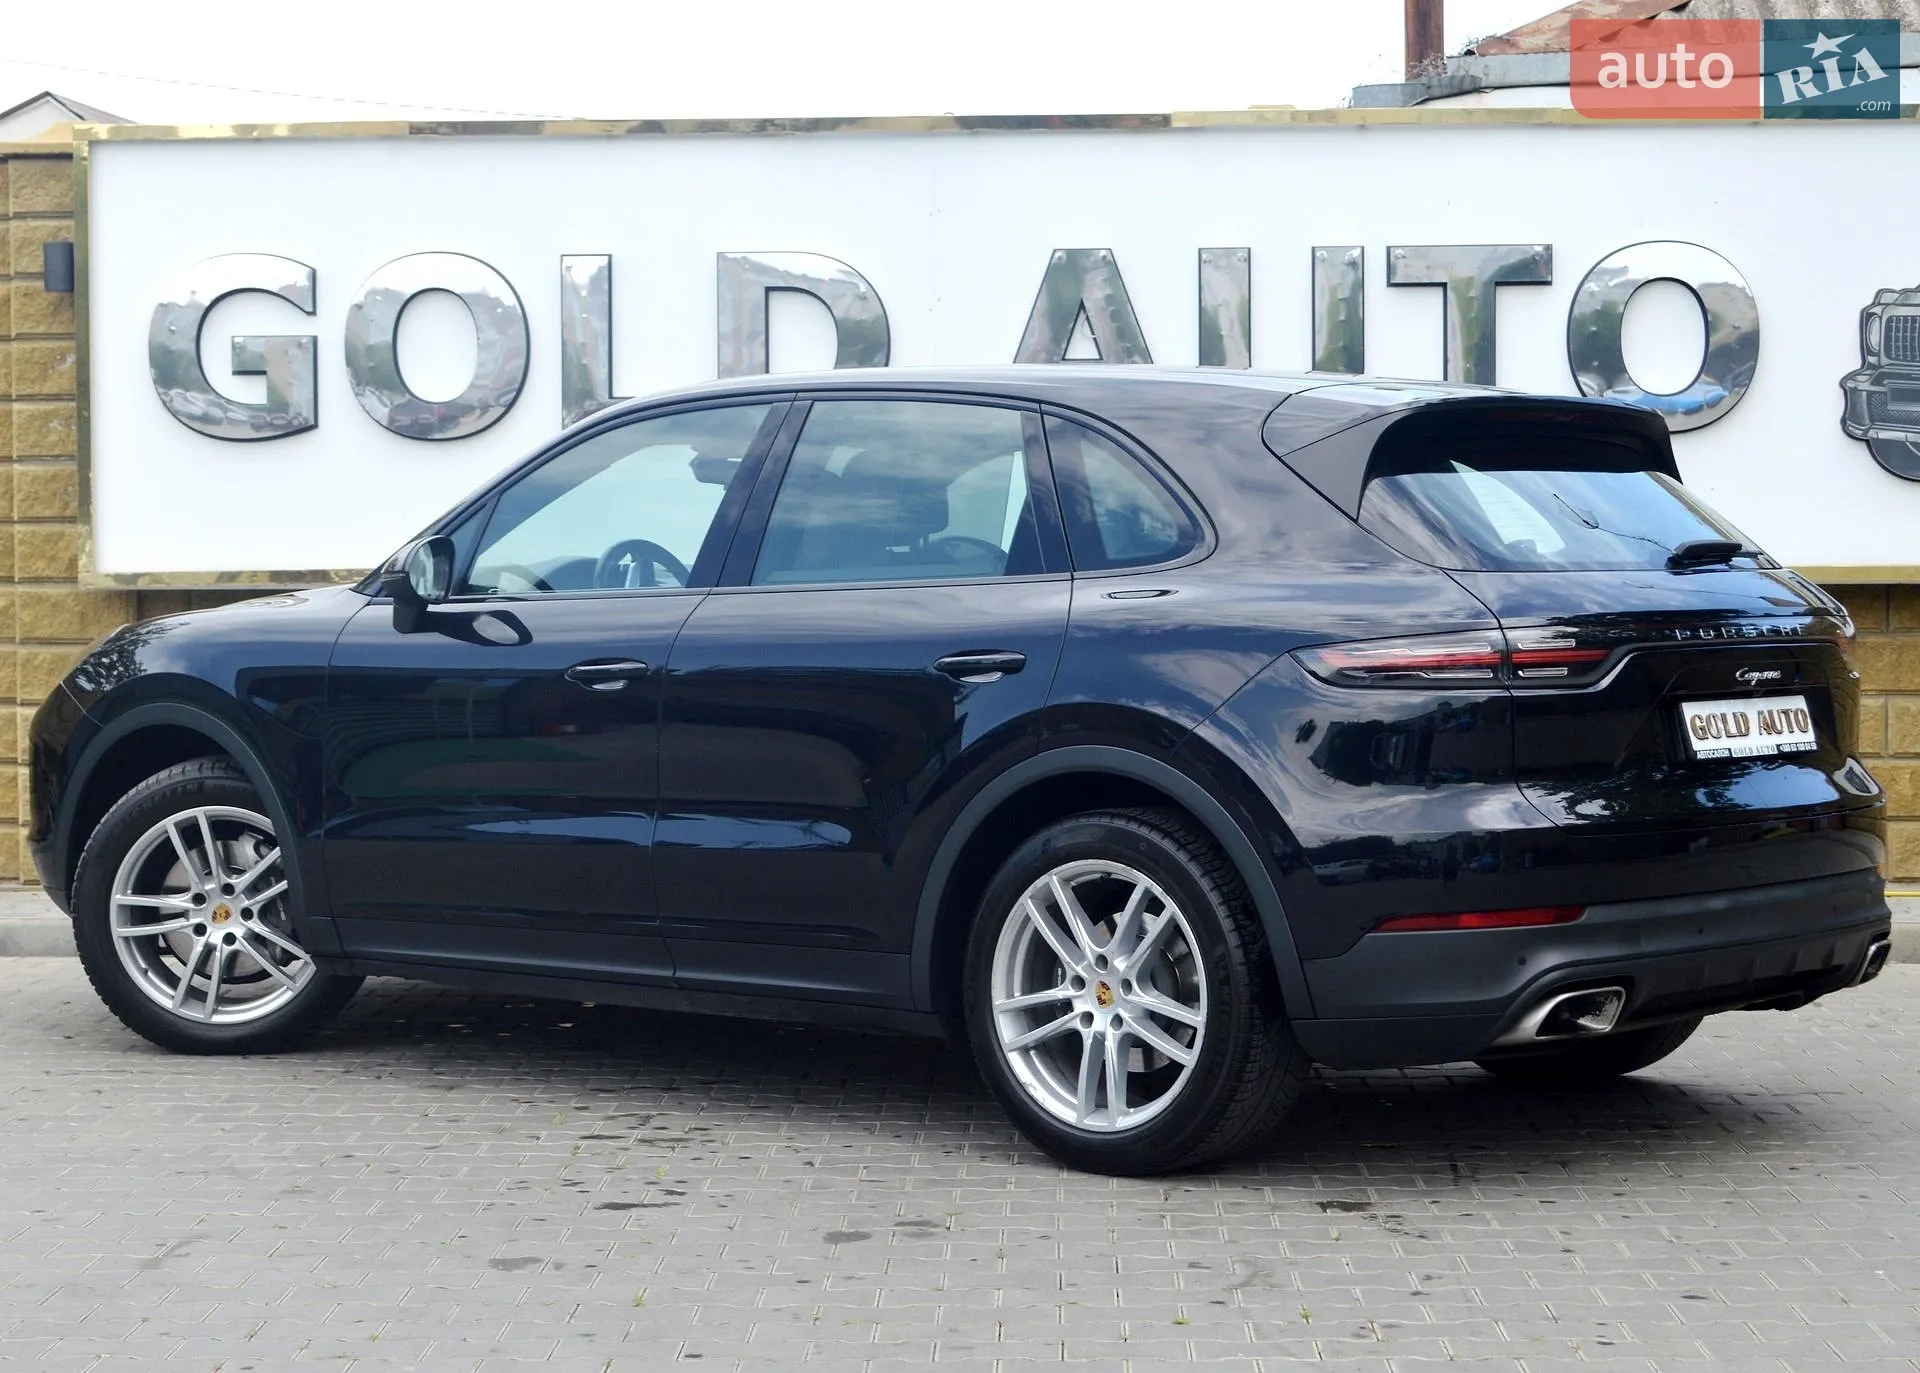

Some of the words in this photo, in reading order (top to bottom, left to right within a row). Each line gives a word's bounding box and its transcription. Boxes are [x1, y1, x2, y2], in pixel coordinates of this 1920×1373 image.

[148, 251, 892, 442] GOLD
[1735, 667, 1782, 686] Cayenne
[1690, 711, 1750, 740] GOLD
[1757, 707, 1809, 736] AUTO
[1733, 746, 1754, 757] GOLD
[1756, 744, 1777, 755] AUTO
